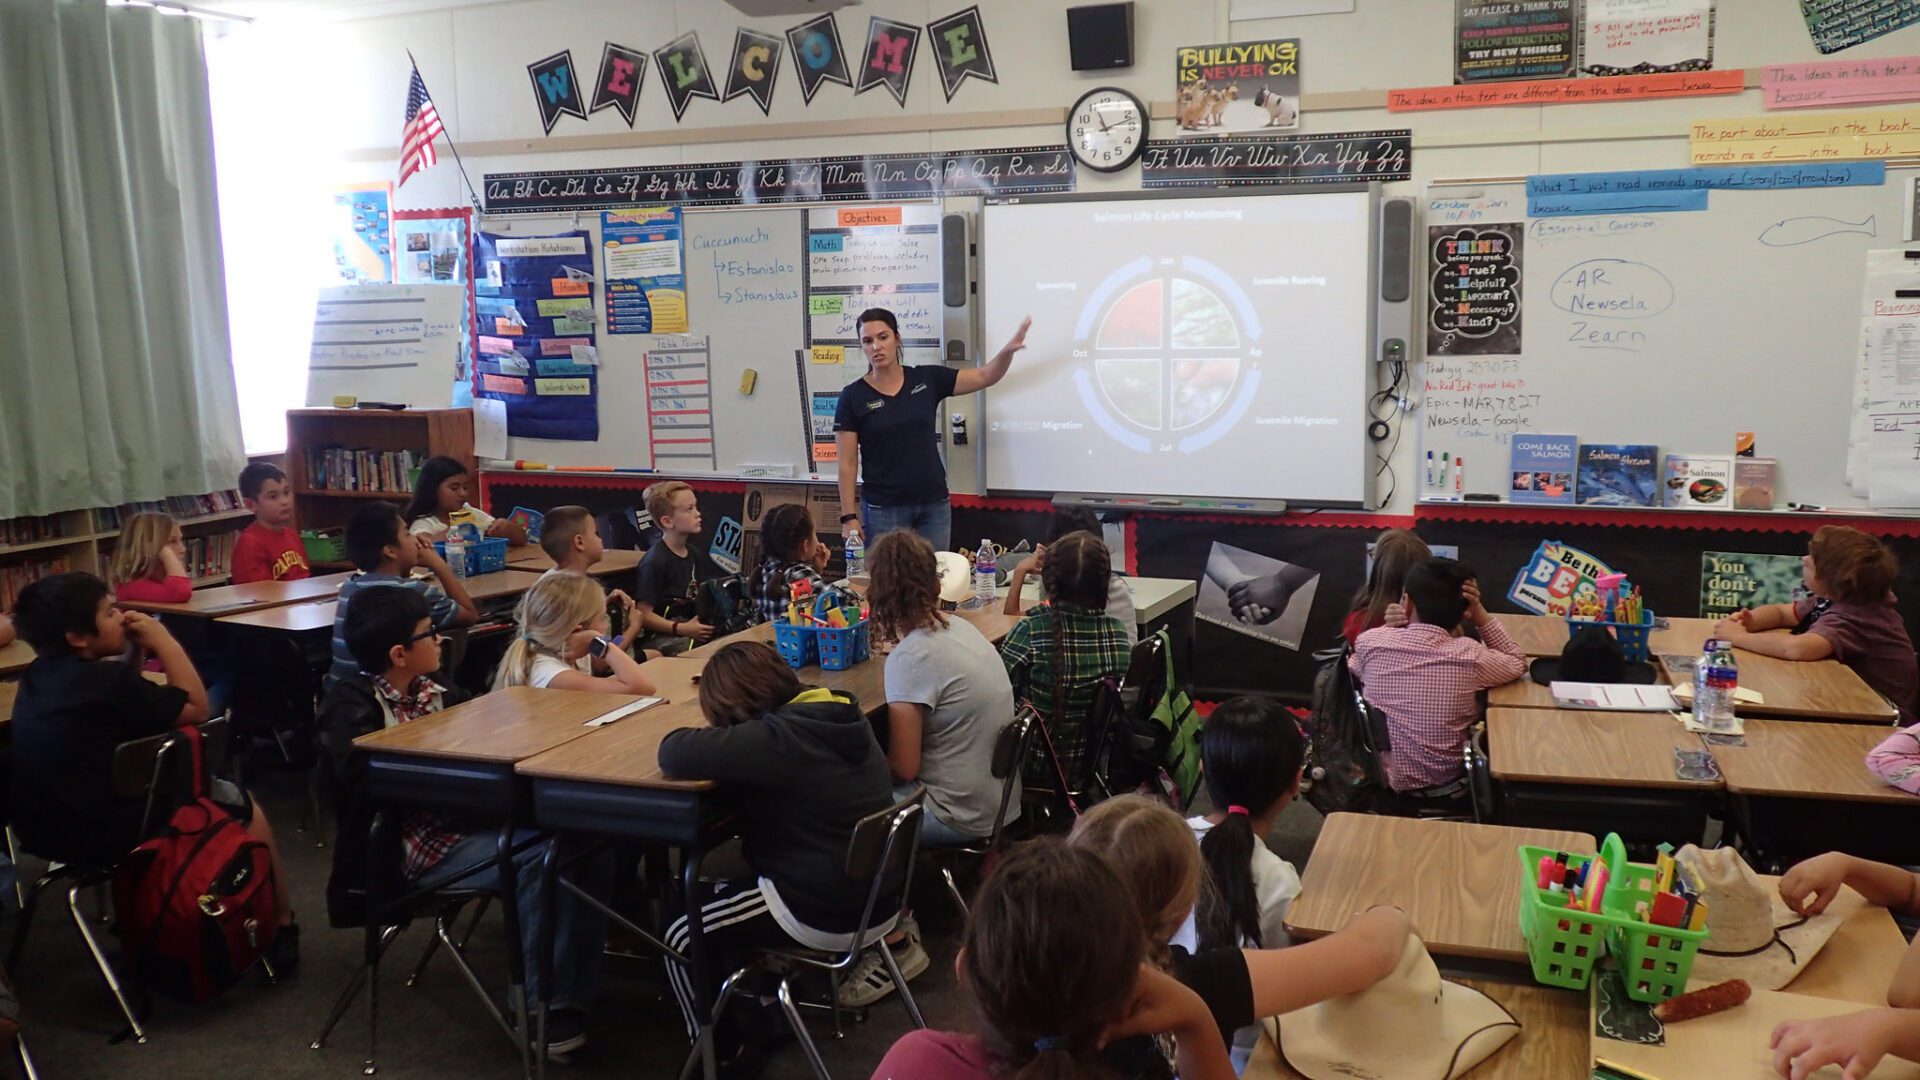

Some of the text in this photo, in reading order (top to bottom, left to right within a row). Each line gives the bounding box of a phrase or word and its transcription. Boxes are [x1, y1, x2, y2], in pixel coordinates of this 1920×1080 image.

[1464, 8, 1478, 17] SAY
[1482, 5, 1511, 15] PLEASE
[1523, 1, 1549, 11] THANK
[1553, 0, 1569, 9] YOU
[1462, 33, 1569, 49] FOLLOW DIRECTIONS
[1179, 42, 1298, 68] BULLYING
[1469, 44, 1562, 59] TRY NEW THINGS
[1462, 54, 1569, 69] BELIEVE YOURSELF
[1180, 61, 1297, 82] IS NEVER OK
[1770, 62, 1906, 83] The ideas in this text
[1393, 94, 1411, 106] The
[1415, 94, 1436, 106] ideas
[1456, 90, 1473, 102] this
[1479, 89, 1498, 101] text
[1504, 90, 1518, 100] are
[1523, 84, 1559, 98] different
[1590, 83, 1608, 96] the
[1775, 89, 1827, 104] because
[1080, 114, 1090, 124] 10
[1076, 127, 1084, 137] 9
[1693, 118, 1910, 141] The part about in the book
[1124, 136, 1132, 145] 4
[1091, 149, 1097, 159] 7
[1103, 151, 1111, 161] 6
[1114, 146, 1122, 156] 5
[1142, 140, 1405, 173] Tt Uu Vv Ww Xx Yy Zz
[1694, 142, 1893, 161] reminds me of the book
[488, 181, 510, 200] Aa
[514, 180, 534, 198] Bb
[538, 179, 557, 197] Cc
[560, 177, 586, 197] Dd
[594, 176, 612, 195] Ee
[617, 174, 640, 201] Ff
[644, 174, 669, 200] Gg
[674, 172, 698, 191] Hh
[706, 170, 731, 190] Ii
[759, 168, 786, 188] Kk
[791, 166, 819, 186] Ll
[826, 164, 868, 185] Mm
[874, 161, 907, 182] Nn
[914, 161, 940, 181] Oo
[944, 160, 965, 187] Pp
[971, 158, 1001, 185] Qq
[1007, 156, 1036, 176] Rr
[1042, 154, 1070, 174] Ss
[1532, 177, 1713, 194] What I just read me
[1534, 201, 1571, 214] because
[843, 211, 887, 226] Objectives
[1094, 209, 1243, 222] Salmon Life Cycle Monitoring
[1538, 221, 1600, 237] Essential
[693, 227, 769, 250] Cuccunuchi
[813, 239, 837, 250] Math
[1446, 239, 1504, 254] THINK
[728, 258, 794, 277] Estanislao
[1458, 263, 1497, 276] True?
[1036, 281, 1077, 291] Spawning
[1254, 276, 1289, 286] Juvenile
[1457, 277, 1506, 290] Helpful?
[735, 287, 799, 303] Stanislaus
[847, 295, 876, 309] Today
[1457, 302, 1515, 316] Necessary?
[1571, 294, 1648, 312] Newsela
[911, 308, 929, 319] edit
[1457, 315, 1494, 327] Kind?
[1569, 322, 1647, 343] Zearn
[653, 337, 678, 350] Table
[813, 349, 840, 364] Reading
[1073, 349, 1088, 358] Oct
[1426, 361, 1462, 379] Prodigy
[1426, 397, 1450, 410] Epic
[1042, 420, 1083, 431] Migration
[1256, 415, 1292, 425] Juvenile
[1294, 415, 1338, 427] Migration
[1428, 413, 1532, 433] Newsela Google
[1873, 418, 1899, 431] End
[815, 447, 838, 458] Science
[1159, 443, 1173, 453] Jul
[1517, 442, 1570, 452] COME BACK
[1532, 450, 1571, 459] SALMON
[1589, 450, 1650, 466] Salmon Stream
[1690, 468, 1725, 478] Salmon
[715, 521, 742, 557] STA
[1560, 550, 1582, 570] Be
[1710, 557, 1745, 574] You
[1708, 574, 1757, 592] don't
[1519, 587, 1548, 606] person
[1708, 591, 1739, 608] fail
